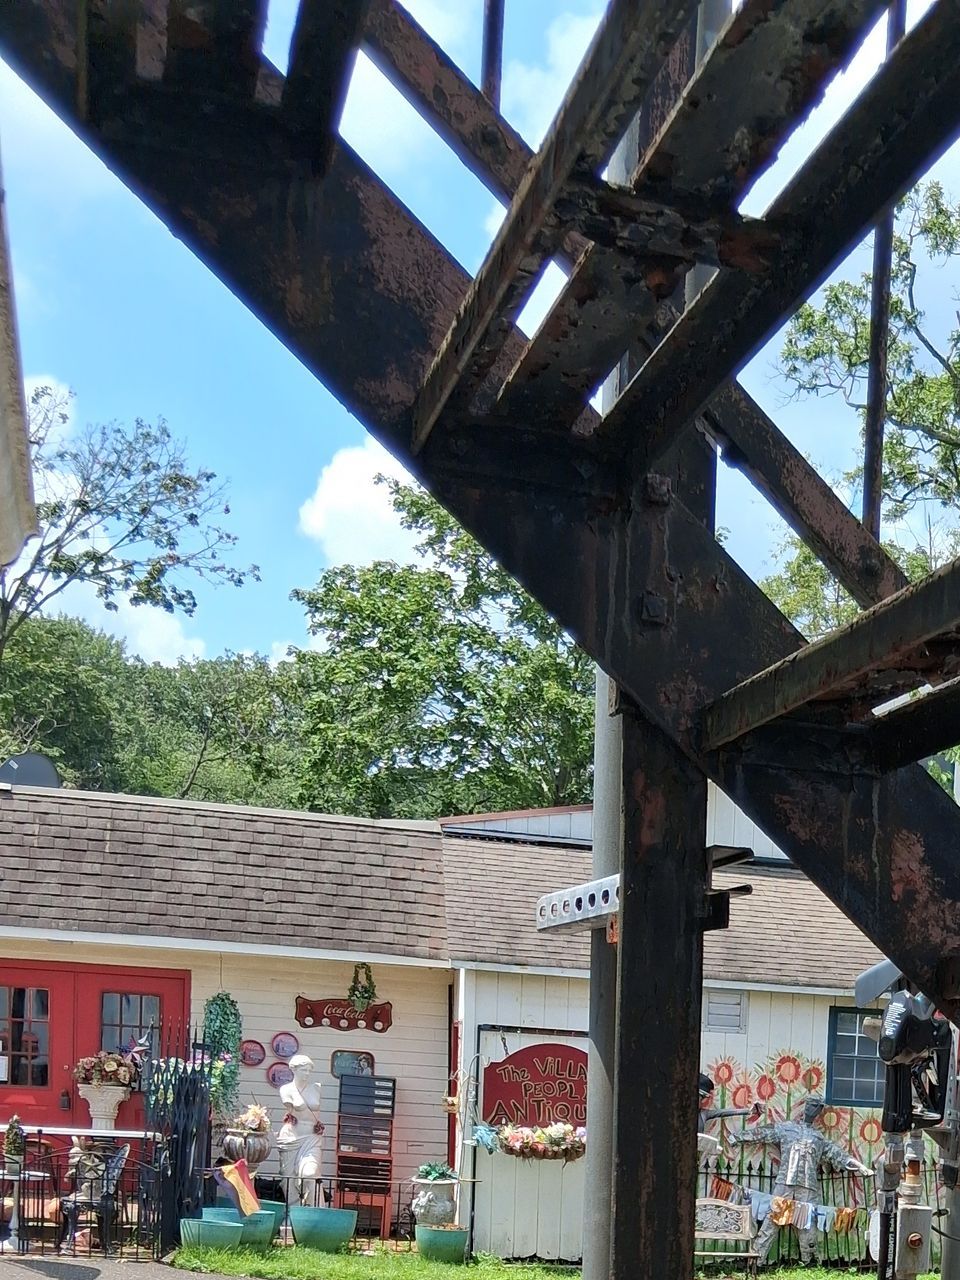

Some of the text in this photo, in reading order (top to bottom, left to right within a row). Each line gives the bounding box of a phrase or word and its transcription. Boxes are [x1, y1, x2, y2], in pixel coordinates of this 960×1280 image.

[323, 1003, 366, 1019] Coca-Cola
[497, 1064, 531, 1082] The
[522, 1080, 588, 1100] PEOPL
